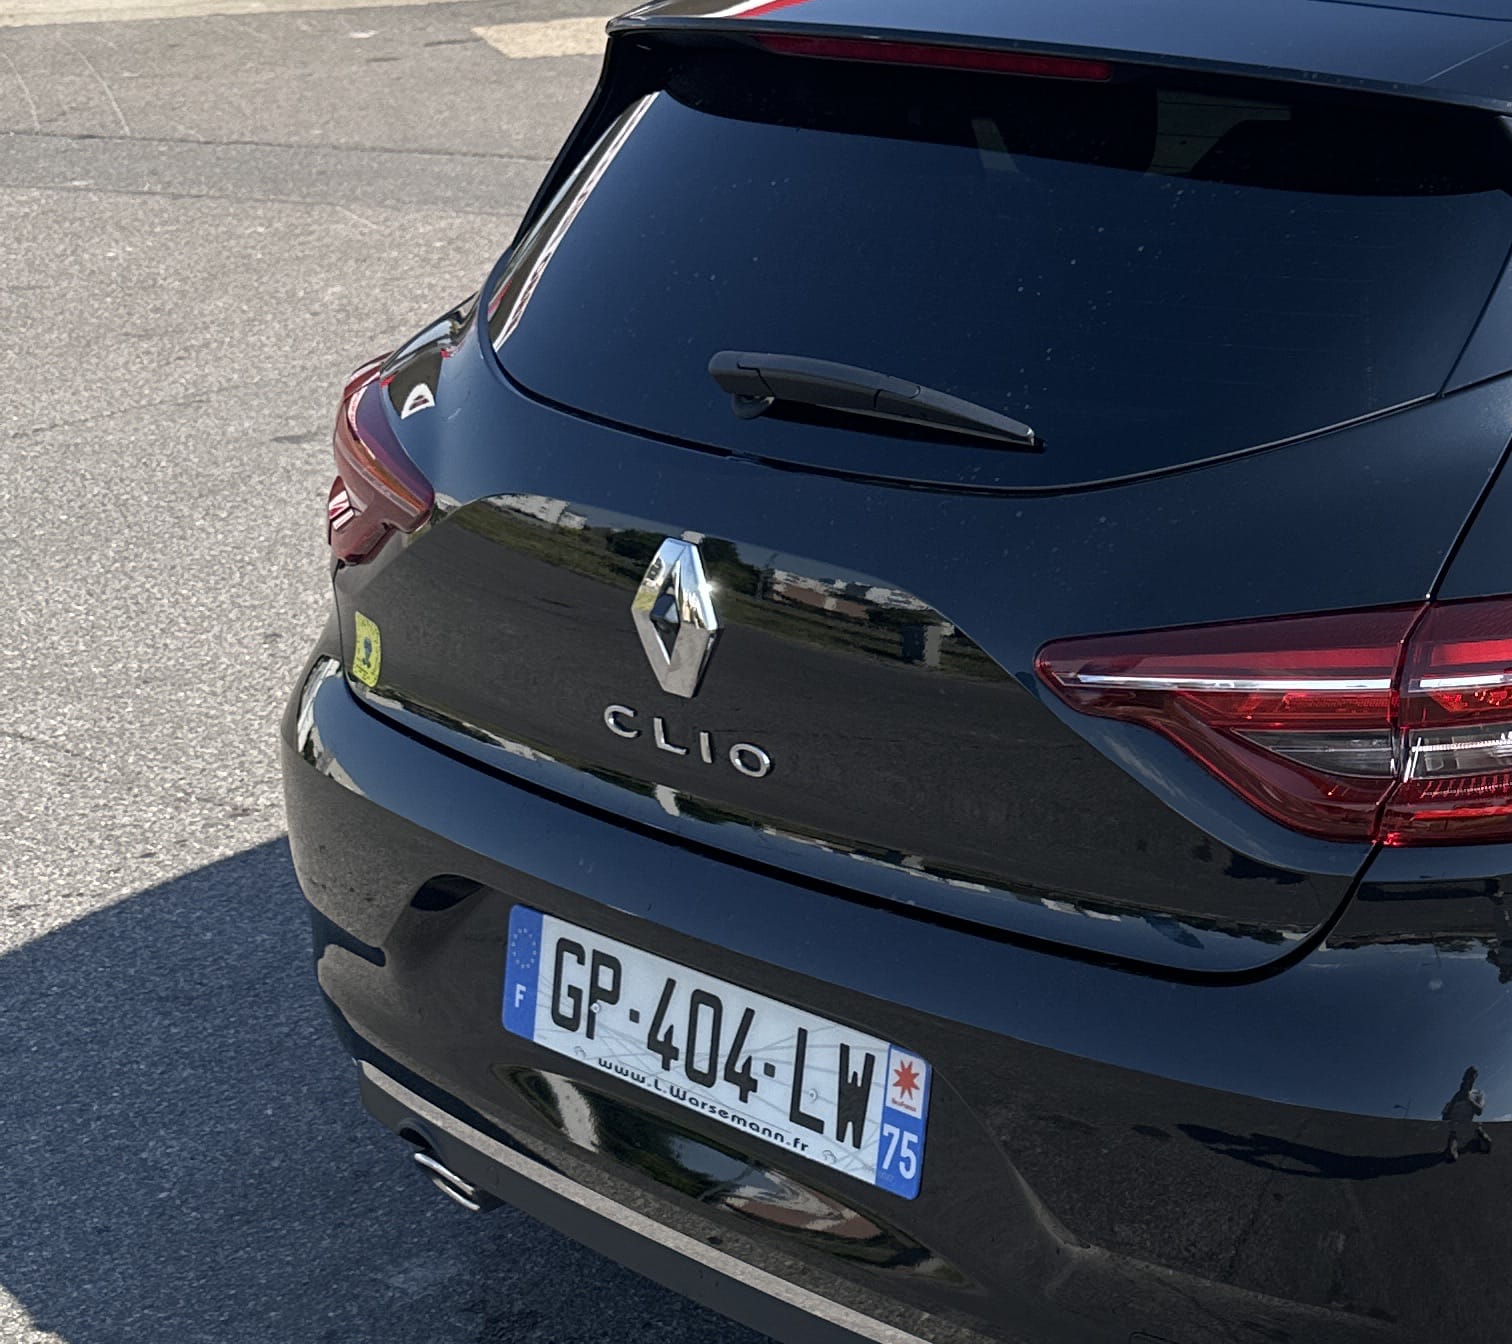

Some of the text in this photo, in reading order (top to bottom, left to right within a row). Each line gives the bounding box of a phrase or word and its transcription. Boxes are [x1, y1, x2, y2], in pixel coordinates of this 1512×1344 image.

[604, 705, 772, 778] CLIO
[514, 983, 527, 1009] F
[550, 937, 876, 1150] GP-404-LW
[599, 1058, 809, 1152] www.L.Warsemann.fr
[881, 1122, 919, 1181] 75
